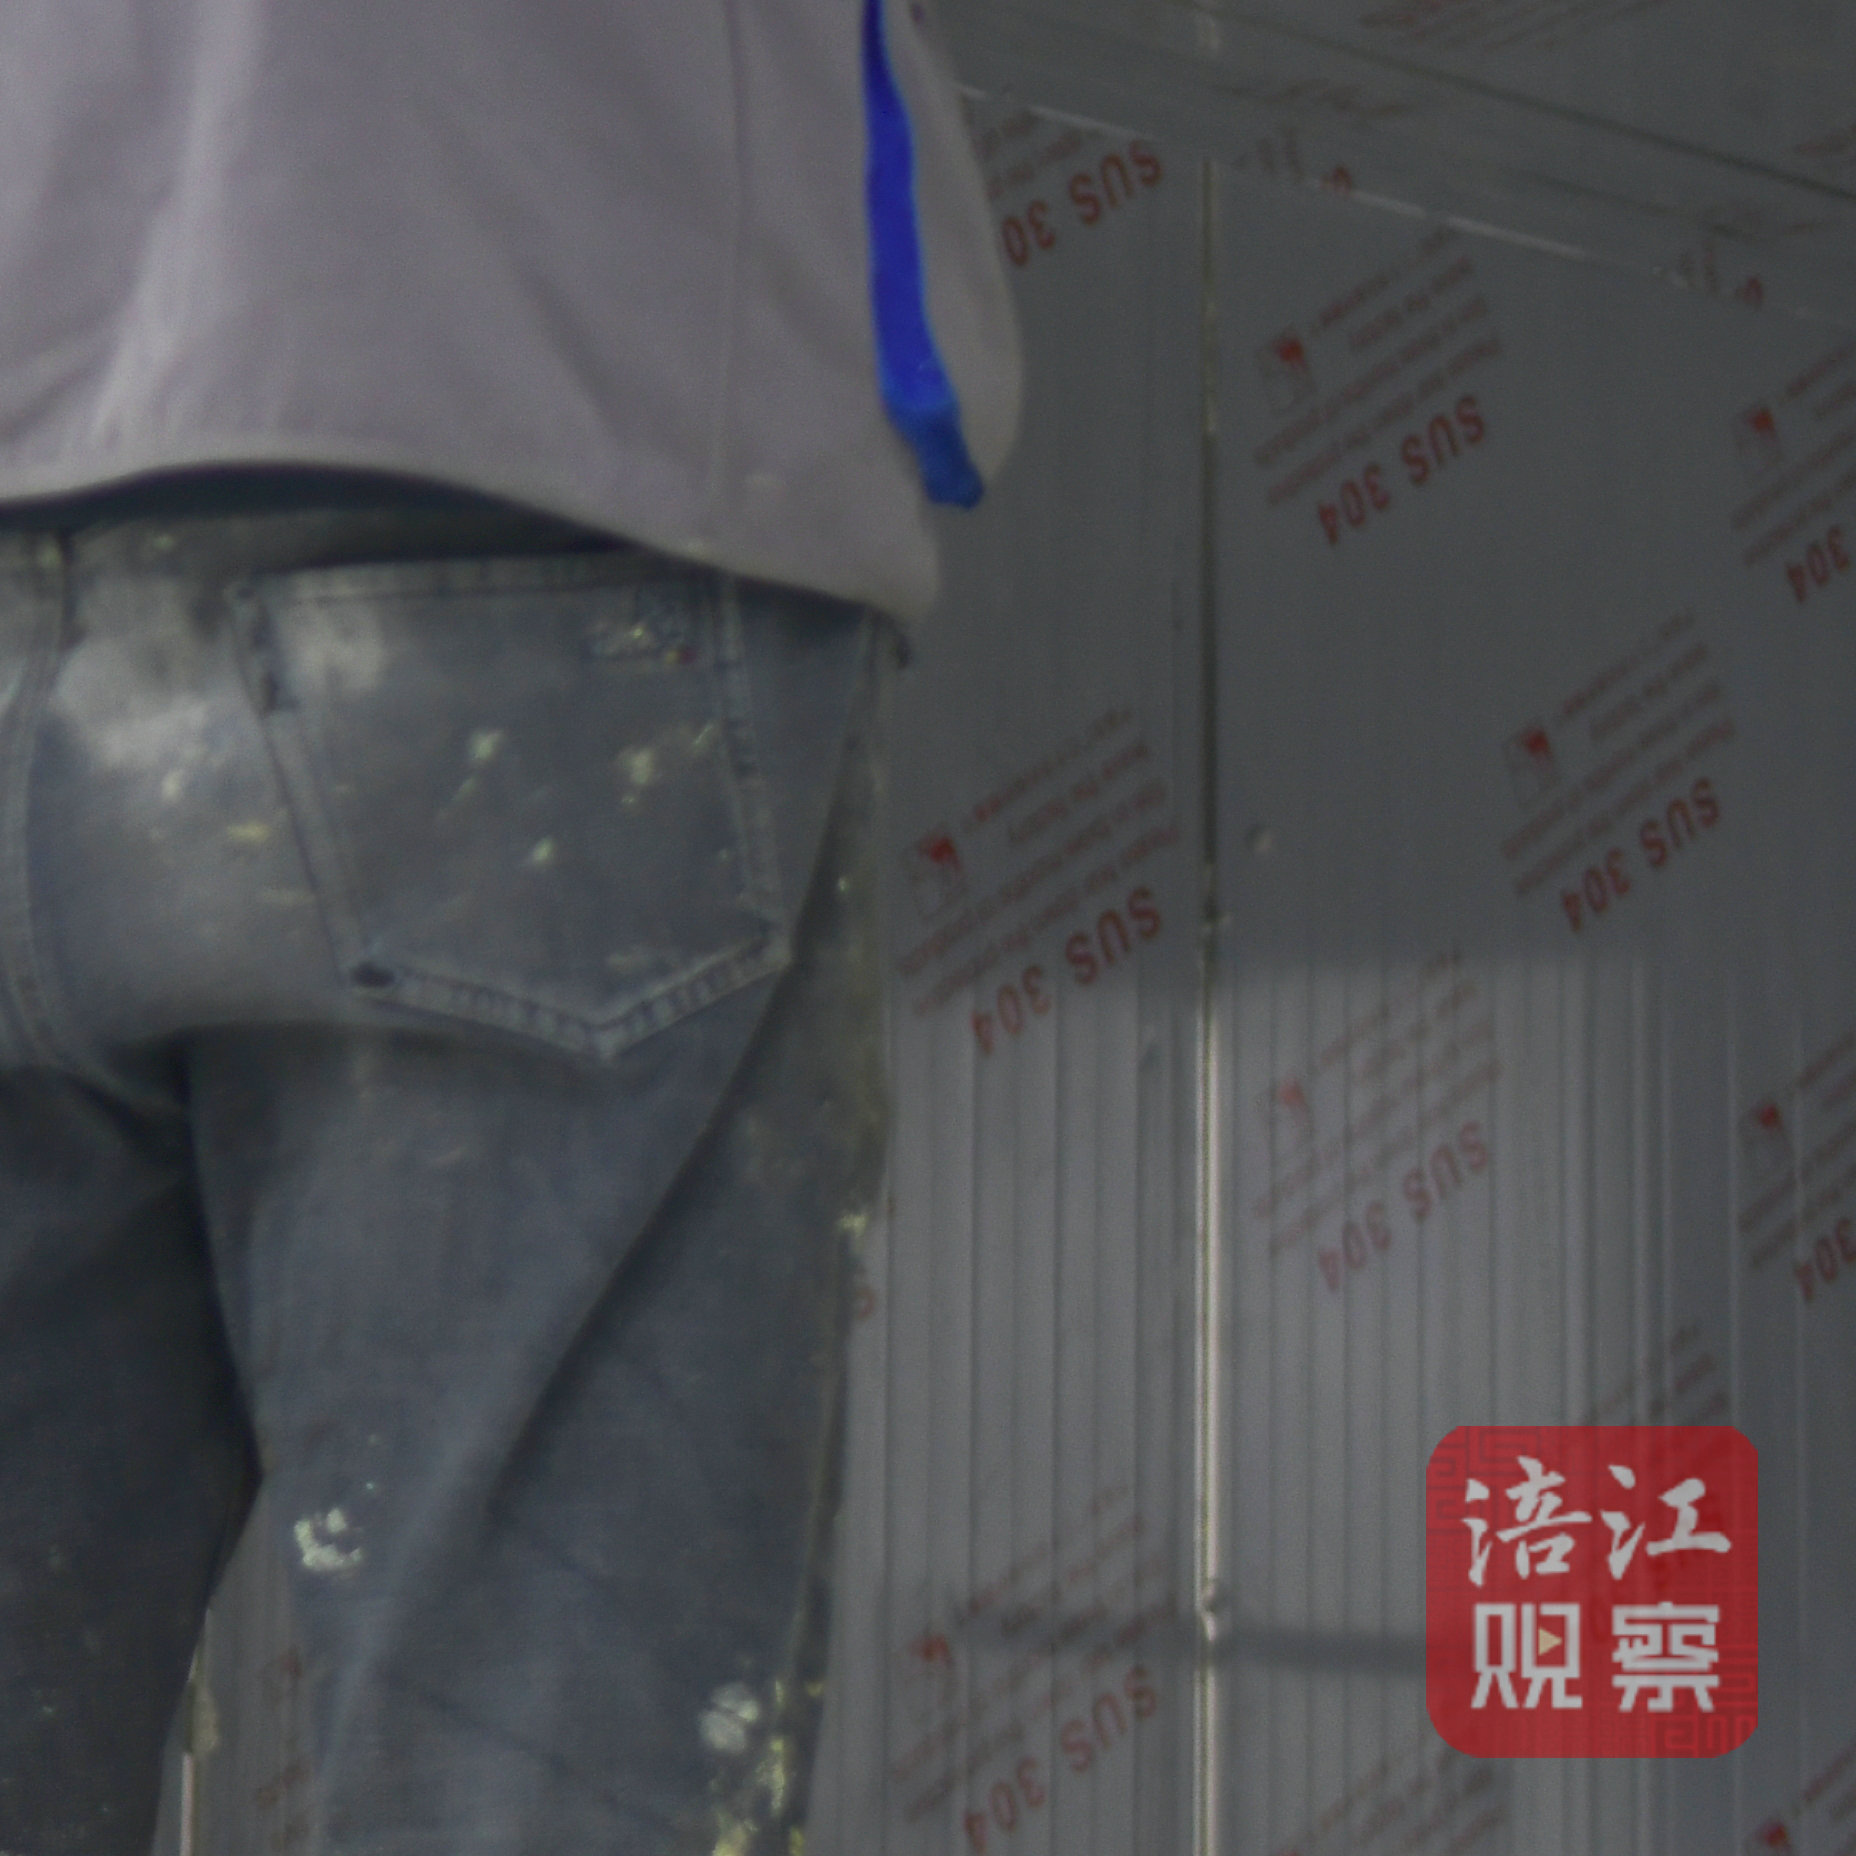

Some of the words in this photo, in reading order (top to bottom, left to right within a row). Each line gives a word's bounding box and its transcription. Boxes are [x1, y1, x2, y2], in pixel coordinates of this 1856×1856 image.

[1069, 142, 1162, 225] SUS
[1401, 395, 1485, 487] SUS
[1318, 463, 1390, 545] 304
[1640, 778, 1720, 869] SUS
[1065, 886, 1162, 984] SUS
[1561, 848, 1631, 932] 304
[972, 964, 1051, 1060] 304
